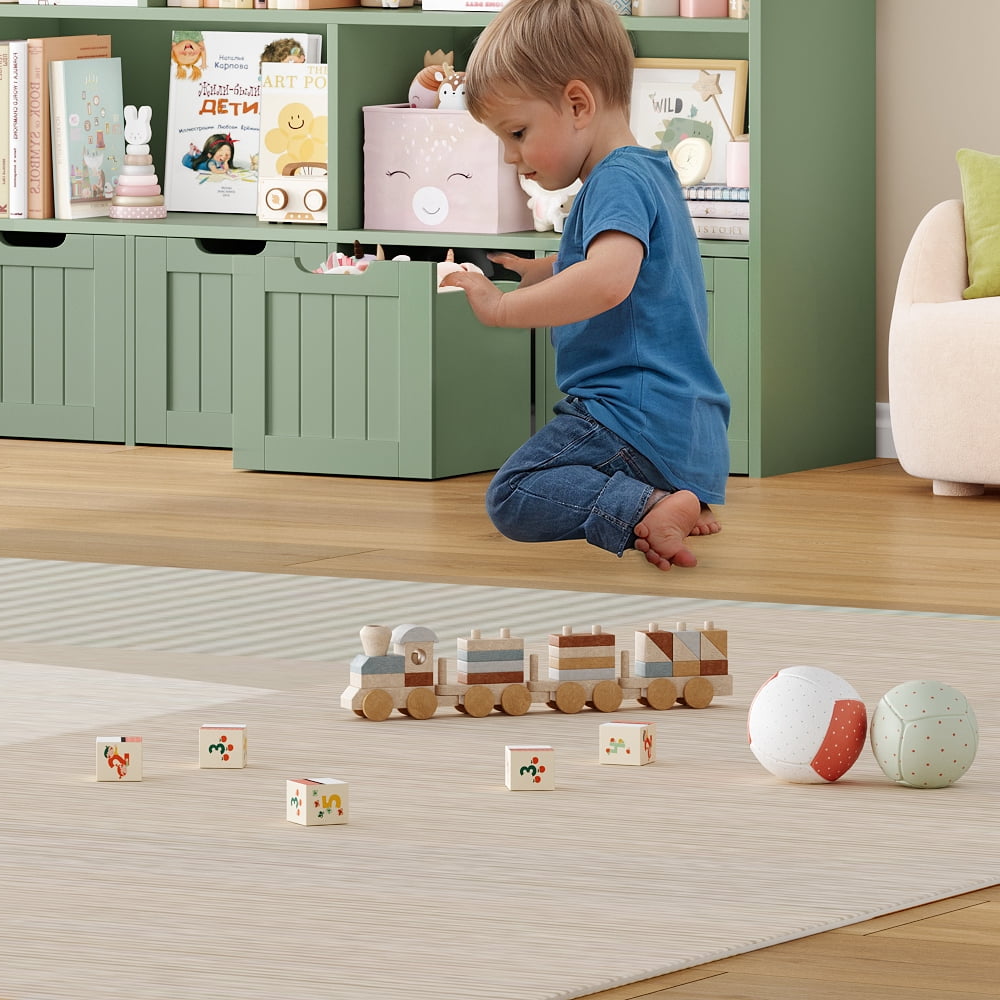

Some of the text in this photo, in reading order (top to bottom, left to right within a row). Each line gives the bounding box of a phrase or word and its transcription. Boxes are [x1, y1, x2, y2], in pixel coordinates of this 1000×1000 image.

[214, 62, 249, 71] Карпова
[262, 75, 297, 88] ART
[651, 97, 683, 114] WILD
